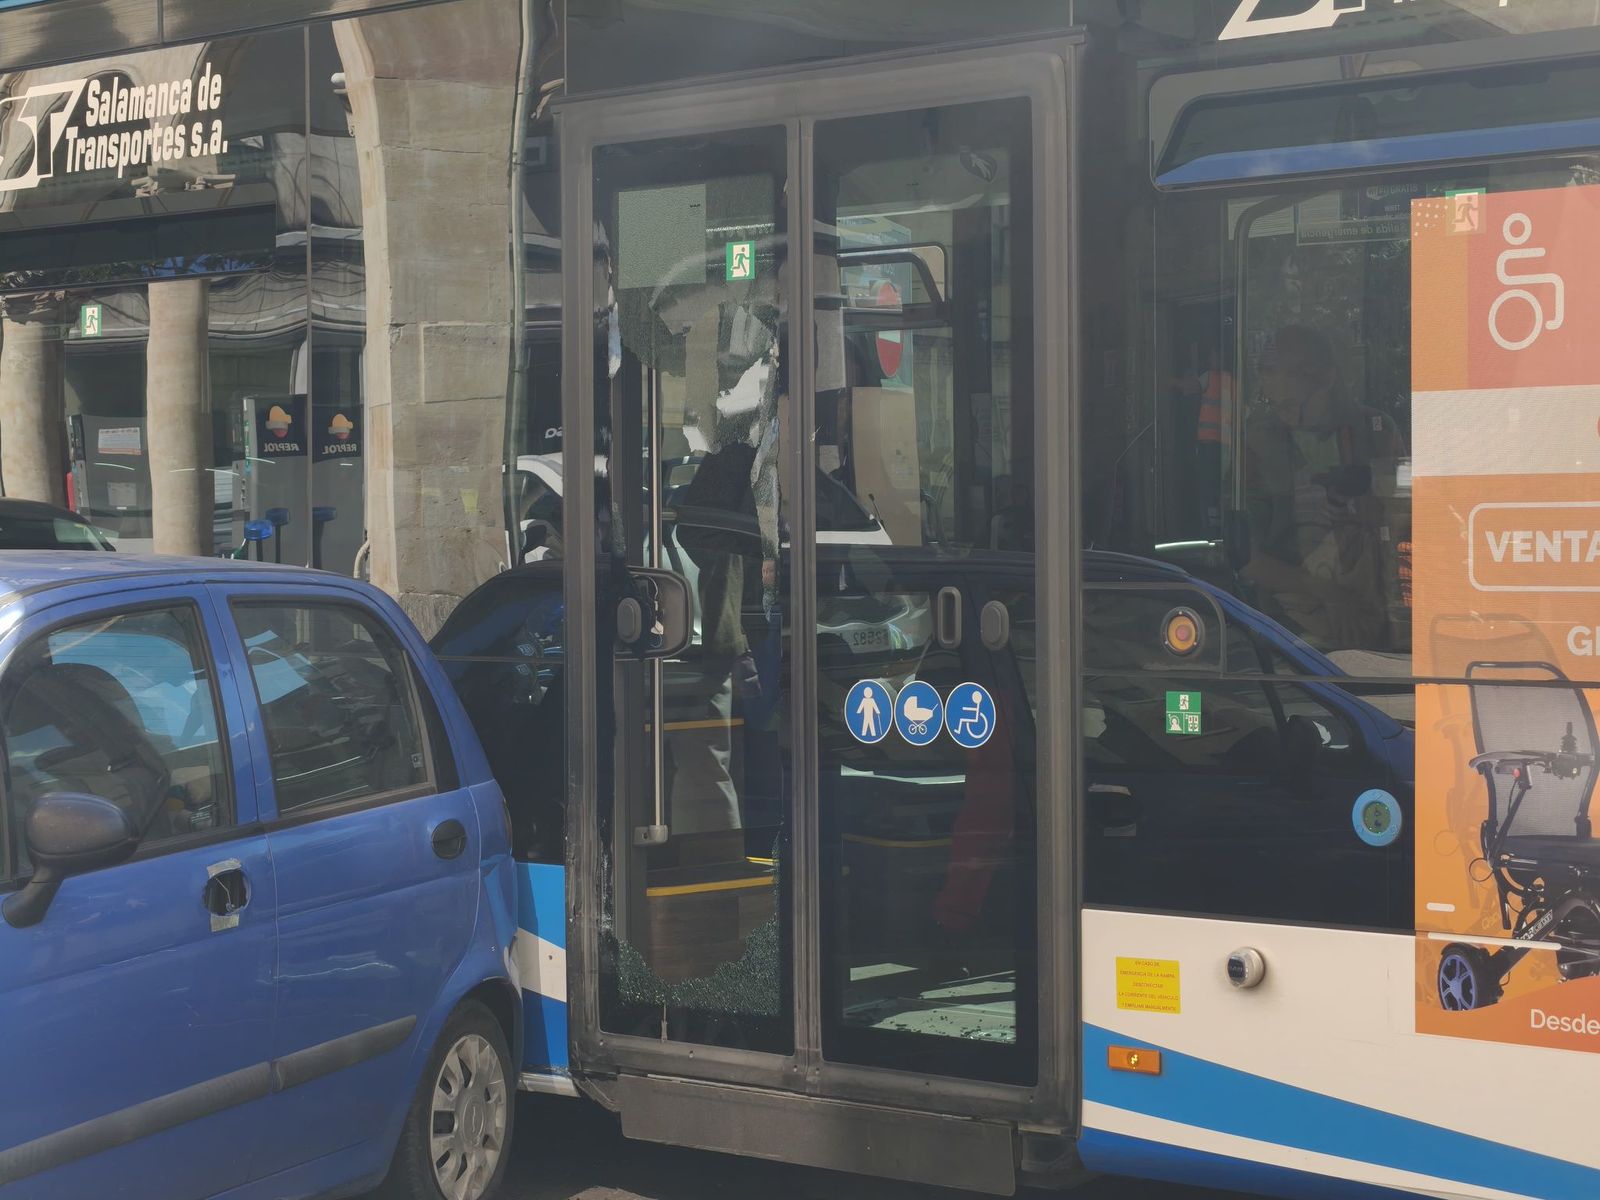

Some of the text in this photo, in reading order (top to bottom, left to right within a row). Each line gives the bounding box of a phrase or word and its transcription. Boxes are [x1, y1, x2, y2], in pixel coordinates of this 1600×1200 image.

[85, 62, 222, 127] Salamanca de
[66, 119, 228, 179] Transportes s.a.
[1530, 1008, 1600, 1035] Desde
